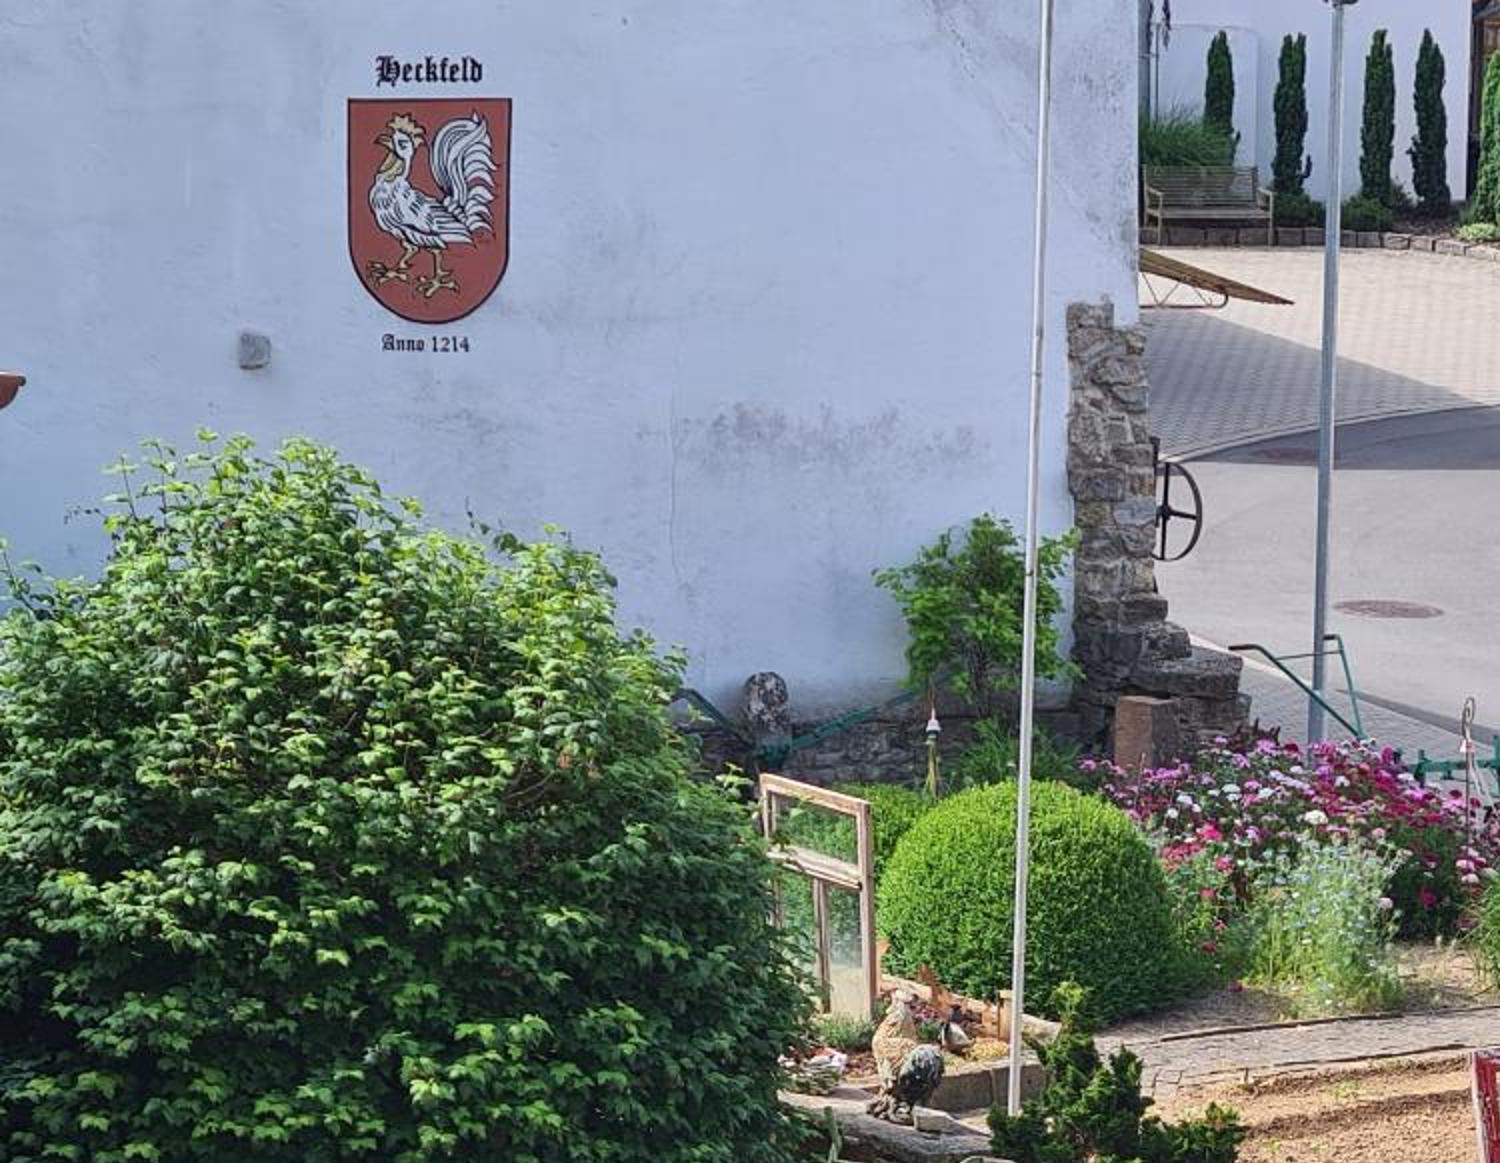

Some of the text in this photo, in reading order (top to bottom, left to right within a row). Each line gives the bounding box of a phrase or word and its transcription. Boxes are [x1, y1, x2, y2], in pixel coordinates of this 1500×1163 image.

[375, 55, 483, 88] Heckfeld
[381, 333, 470, 353] Anno 1214
